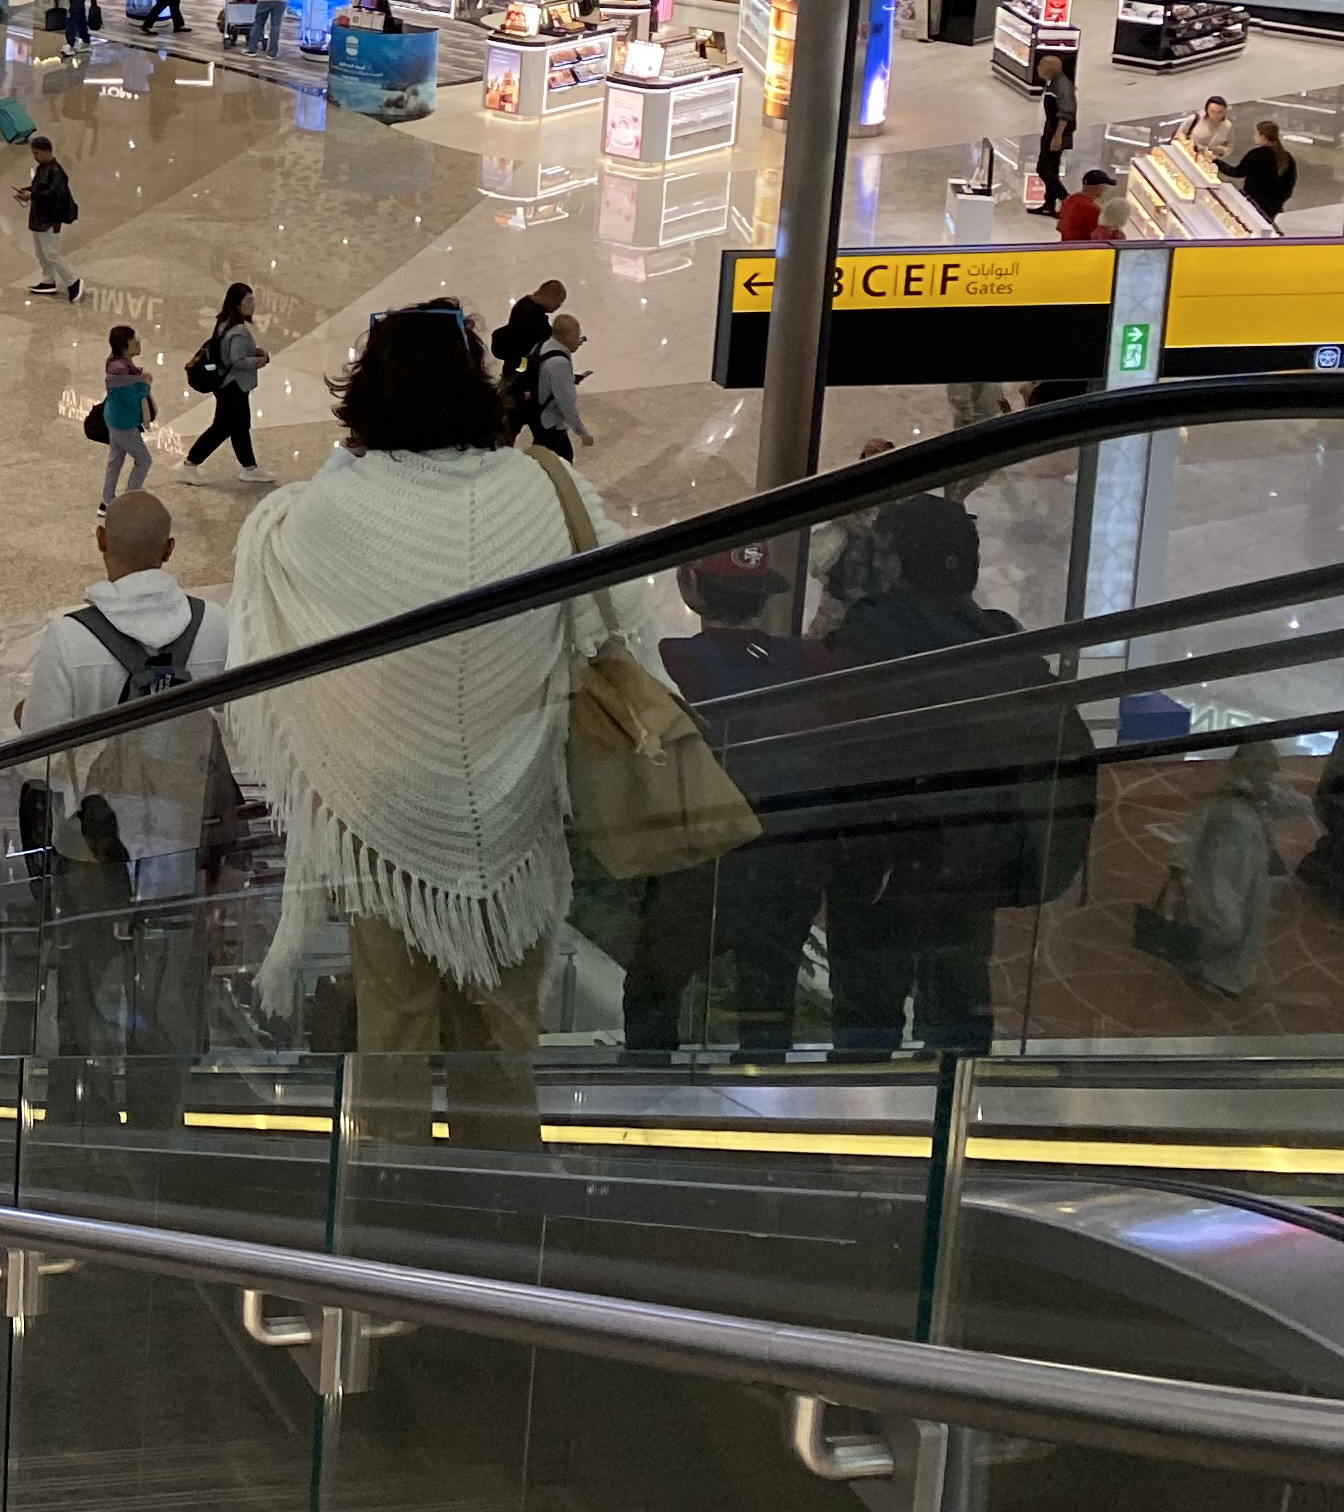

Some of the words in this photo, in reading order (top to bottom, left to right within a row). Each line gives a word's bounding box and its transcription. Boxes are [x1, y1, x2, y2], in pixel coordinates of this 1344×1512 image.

[967, 262, 1020, 279] البوابات
[862, 265, 889, 297] C
[903, 264, 926, 297] E
[939, 263, 961, 296] F
[966, 281, 1014, 296] Gates
